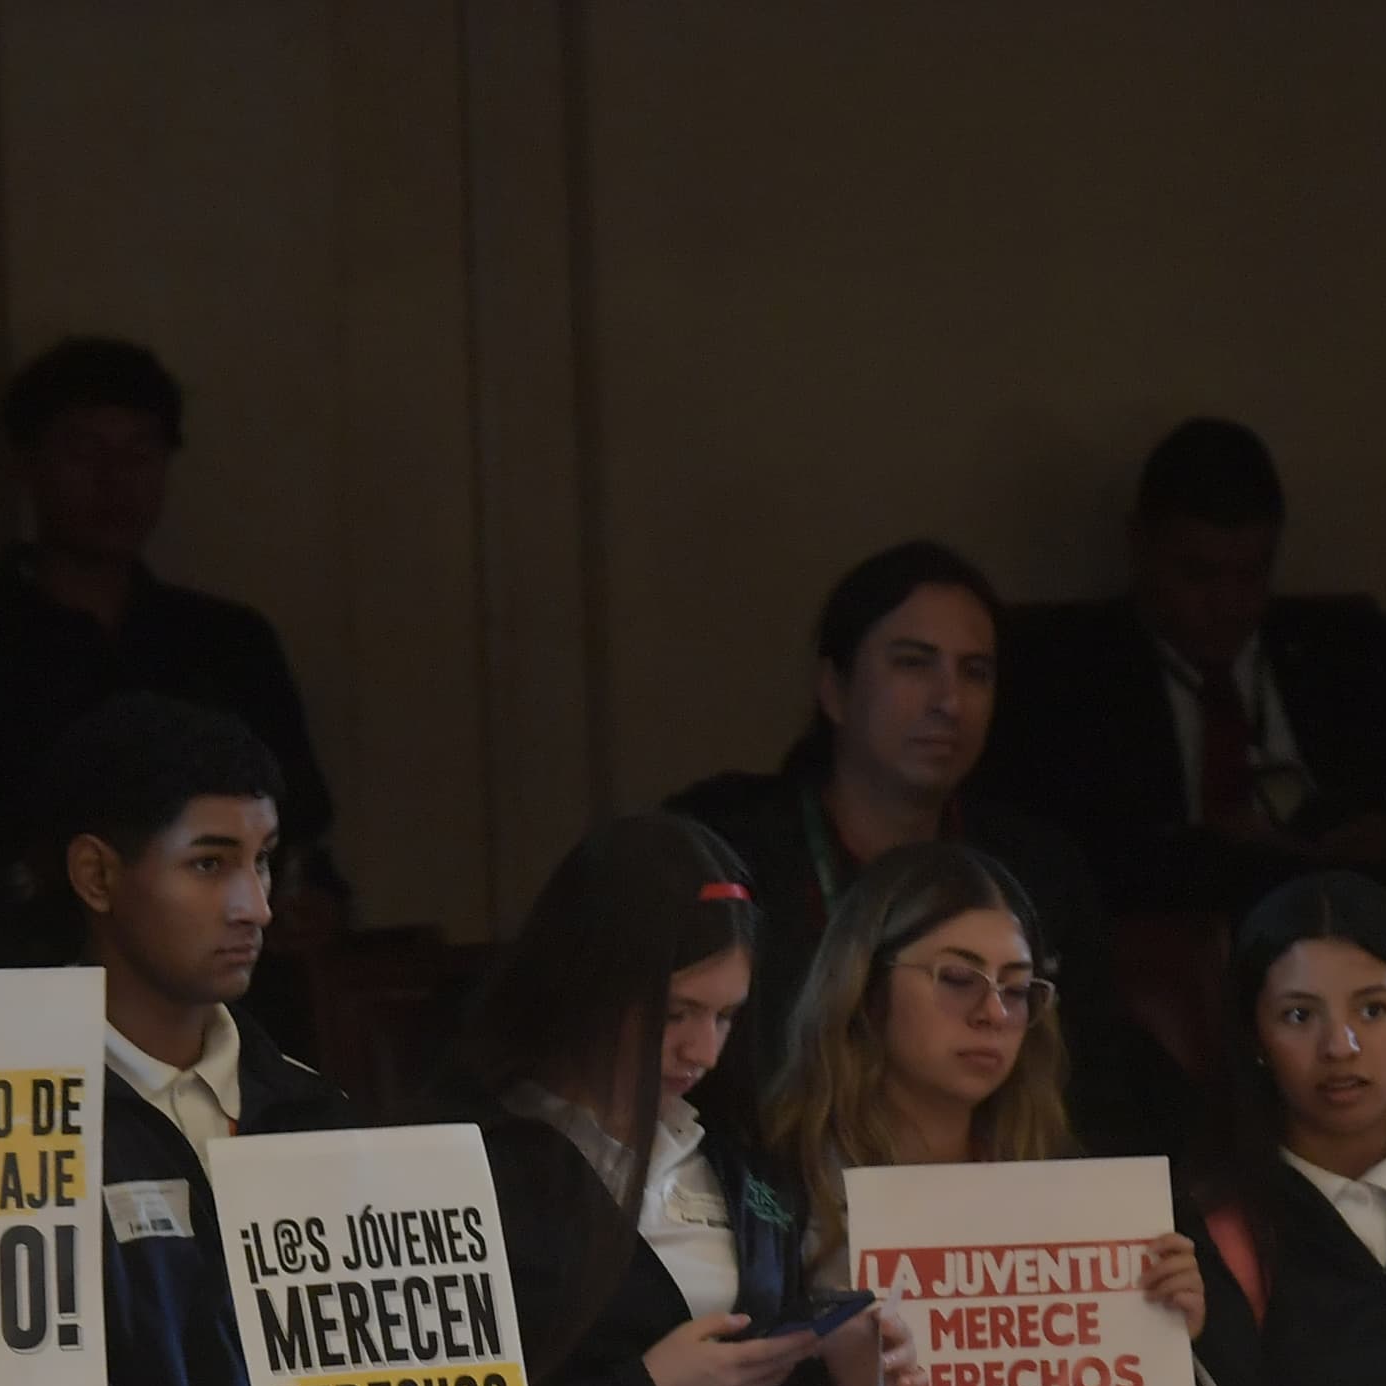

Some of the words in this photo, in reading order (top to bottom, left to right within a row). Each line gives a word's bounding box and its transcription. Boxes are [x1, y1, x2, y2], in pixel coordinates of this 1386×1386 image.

[31, 1078, 84, 1136] DE
[241, 1216, 330, 1283] ¡L@S
[343, 1204, 487, 1271] JÓVENES
[865, 1253, 919, 1299] LA
[255, 1272, 504, 1373] MERECEN
[928, 1302, 1101, 1351] MERECE
